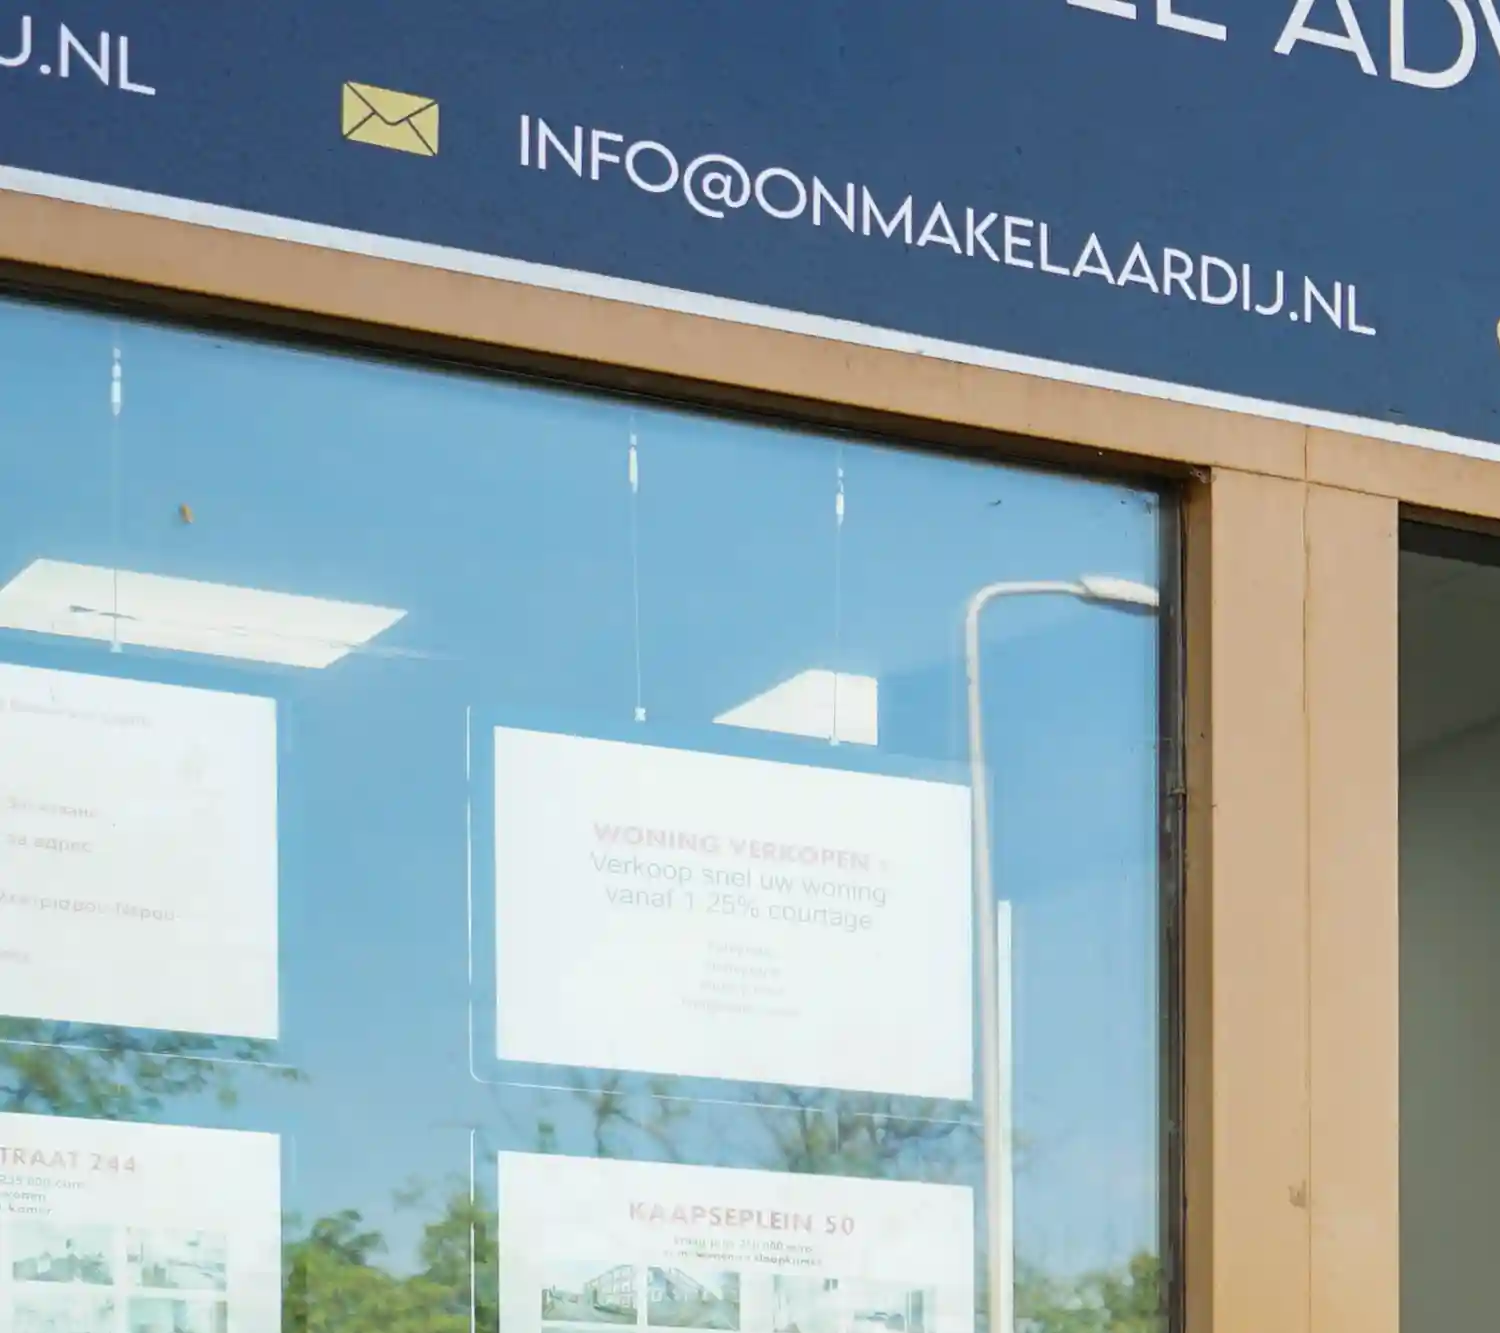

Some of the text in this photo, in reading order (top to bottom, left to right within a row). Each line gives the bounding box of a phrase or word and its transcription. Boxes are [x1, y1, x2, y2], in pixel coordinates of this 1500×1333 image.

[519, 114, 1377, 336] INFO@ONMAKELAARDIJ.NL
[590, 850, 692, 885] Verkoop
[702, 863, 751, 890] snel
[802, 877, 887, 908] woning
